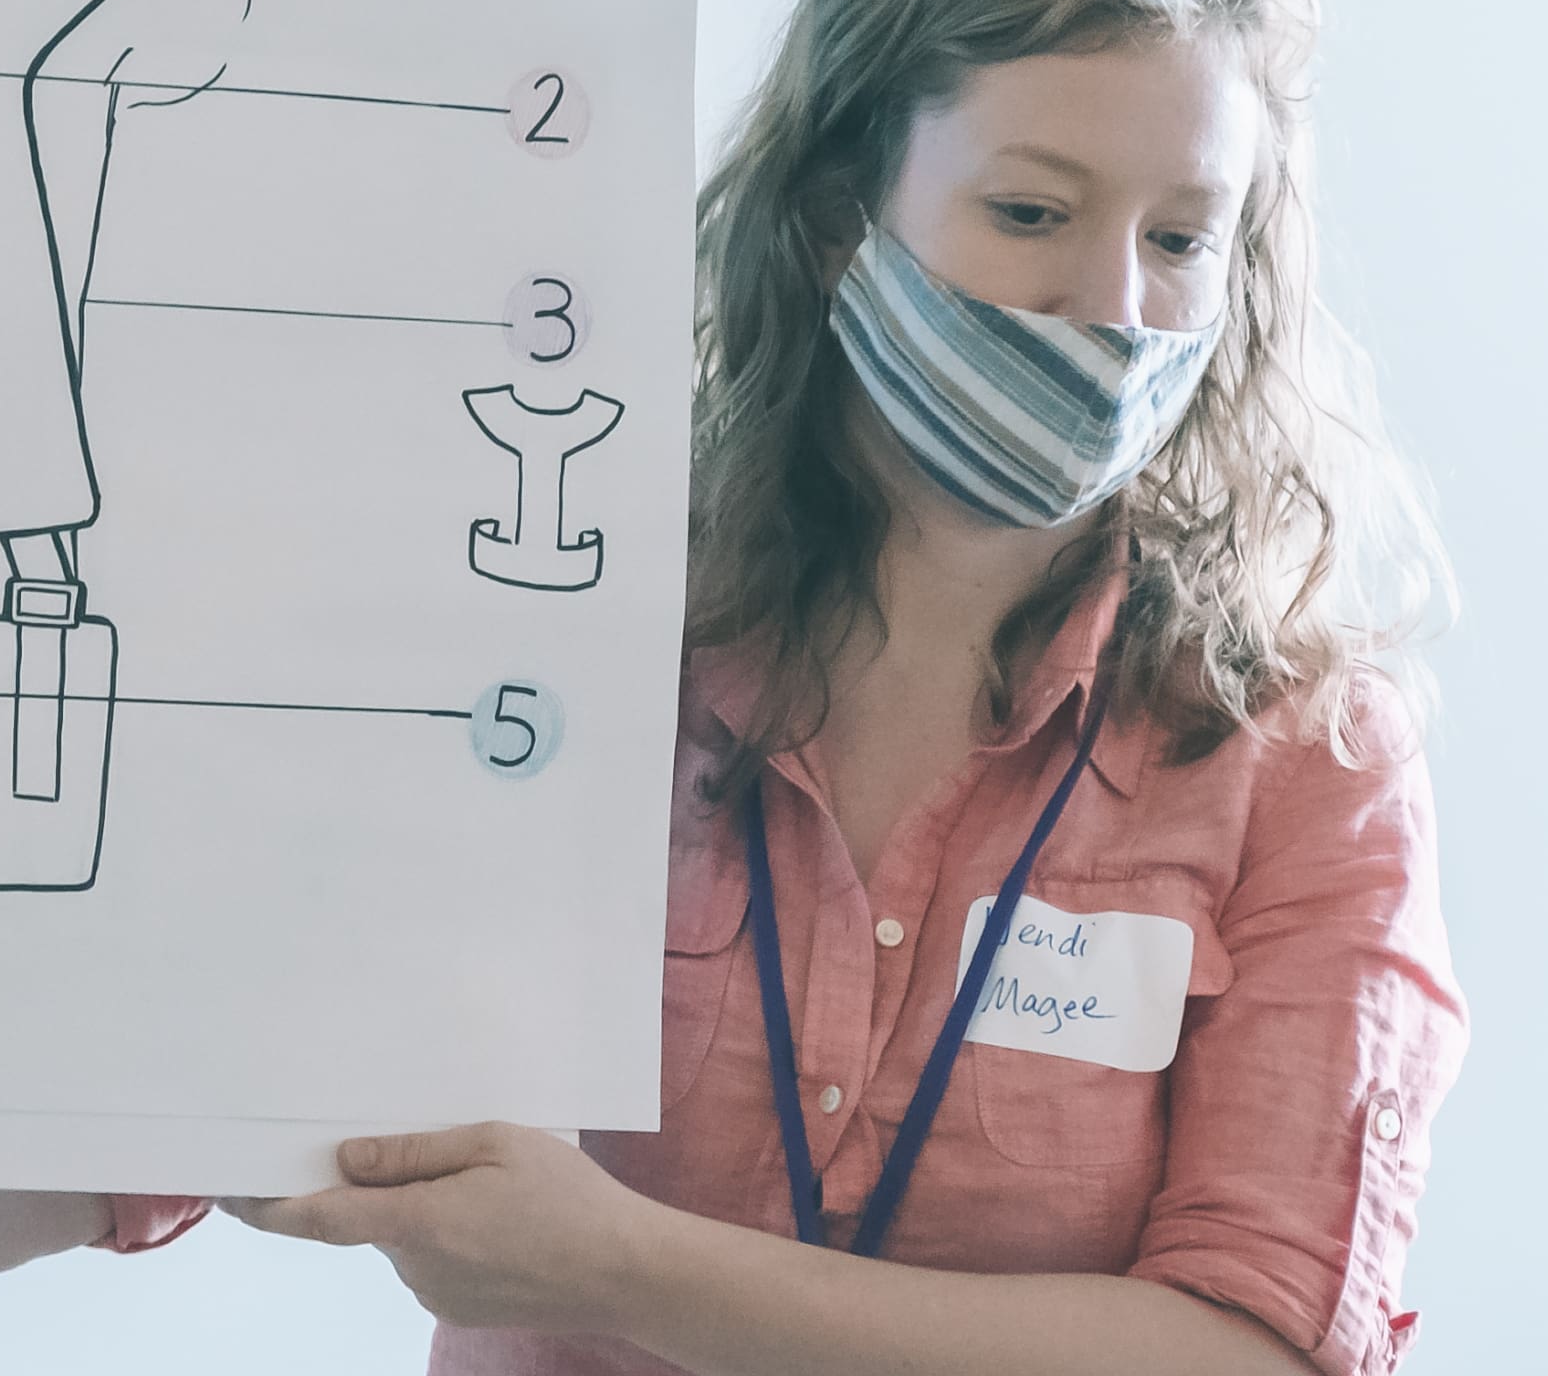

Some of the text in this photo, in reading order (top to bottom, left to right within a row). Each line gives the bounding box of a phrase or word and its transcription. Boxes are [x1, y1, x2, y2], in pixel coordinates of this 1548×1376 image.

[524, 72, 570, 145] 2
[530, 278, 578, 364] 3
[488, 683, 539, 767] 5
[980, 976, 1119, 1034] Magee
